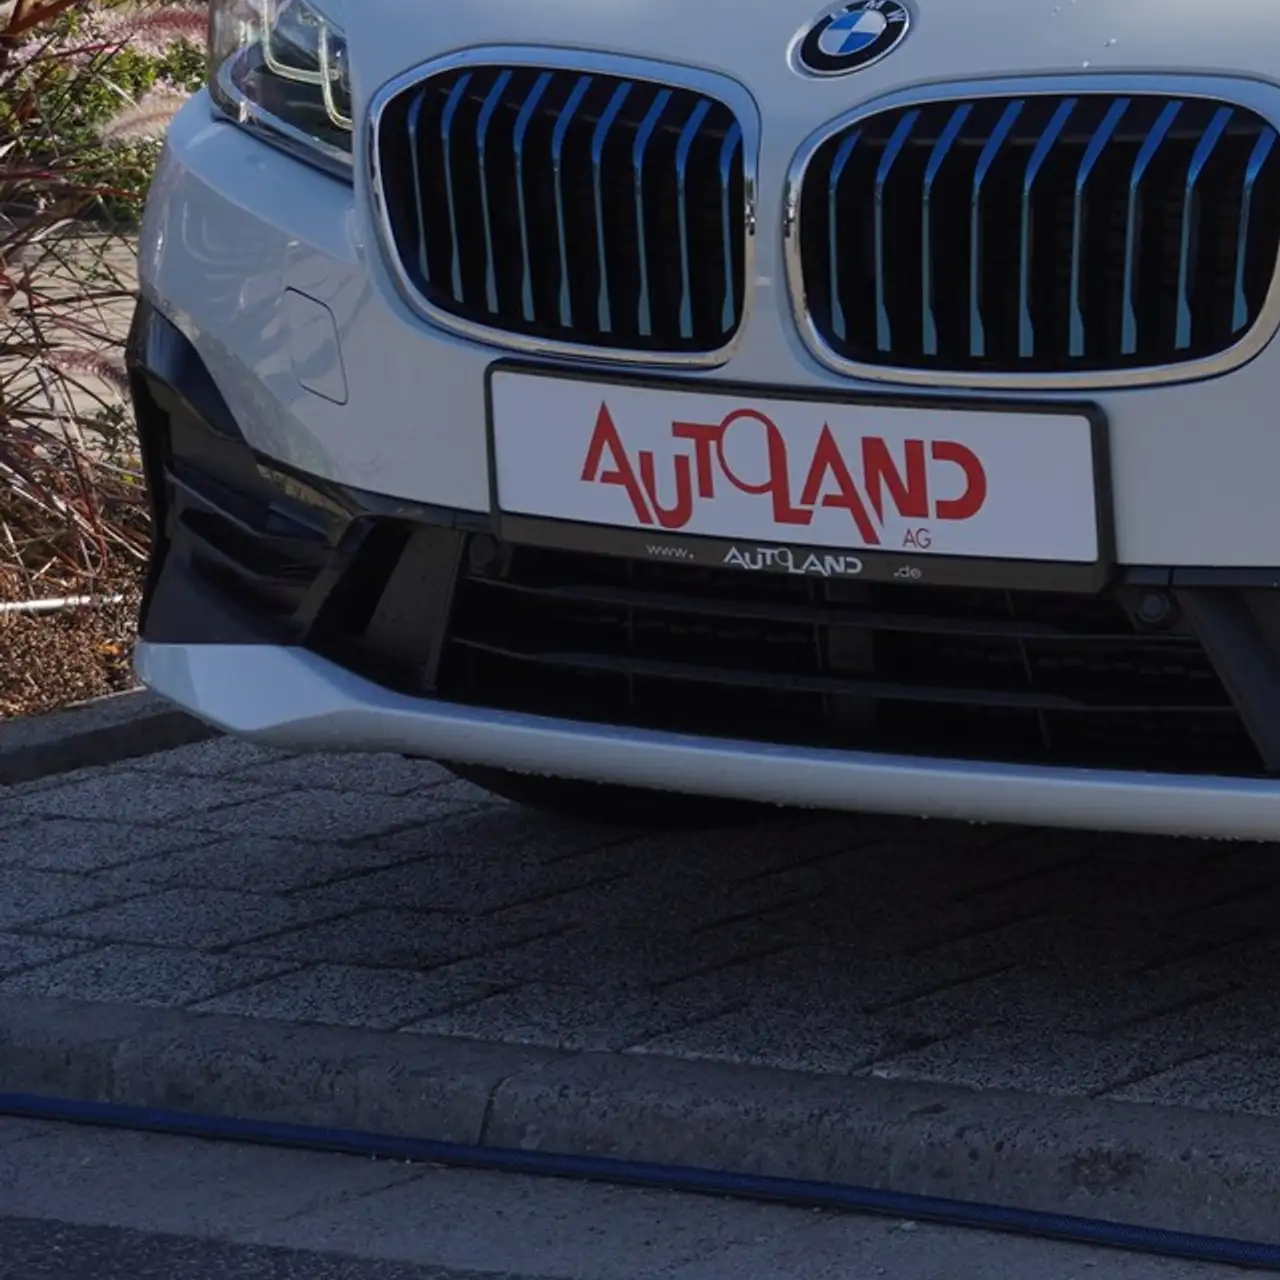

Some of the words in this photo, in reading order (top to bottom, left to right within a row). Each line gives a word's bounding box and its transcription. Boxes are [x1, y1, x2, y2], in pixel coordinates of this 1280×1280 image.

[581, 400, 987, 546] AUTOLAND
[902, 528, 932, 549] AG
[646, 544, 694, 559] www.
[723, 546, 863, 576] AUTOLAND
[893, 564, 922, 580] .de
